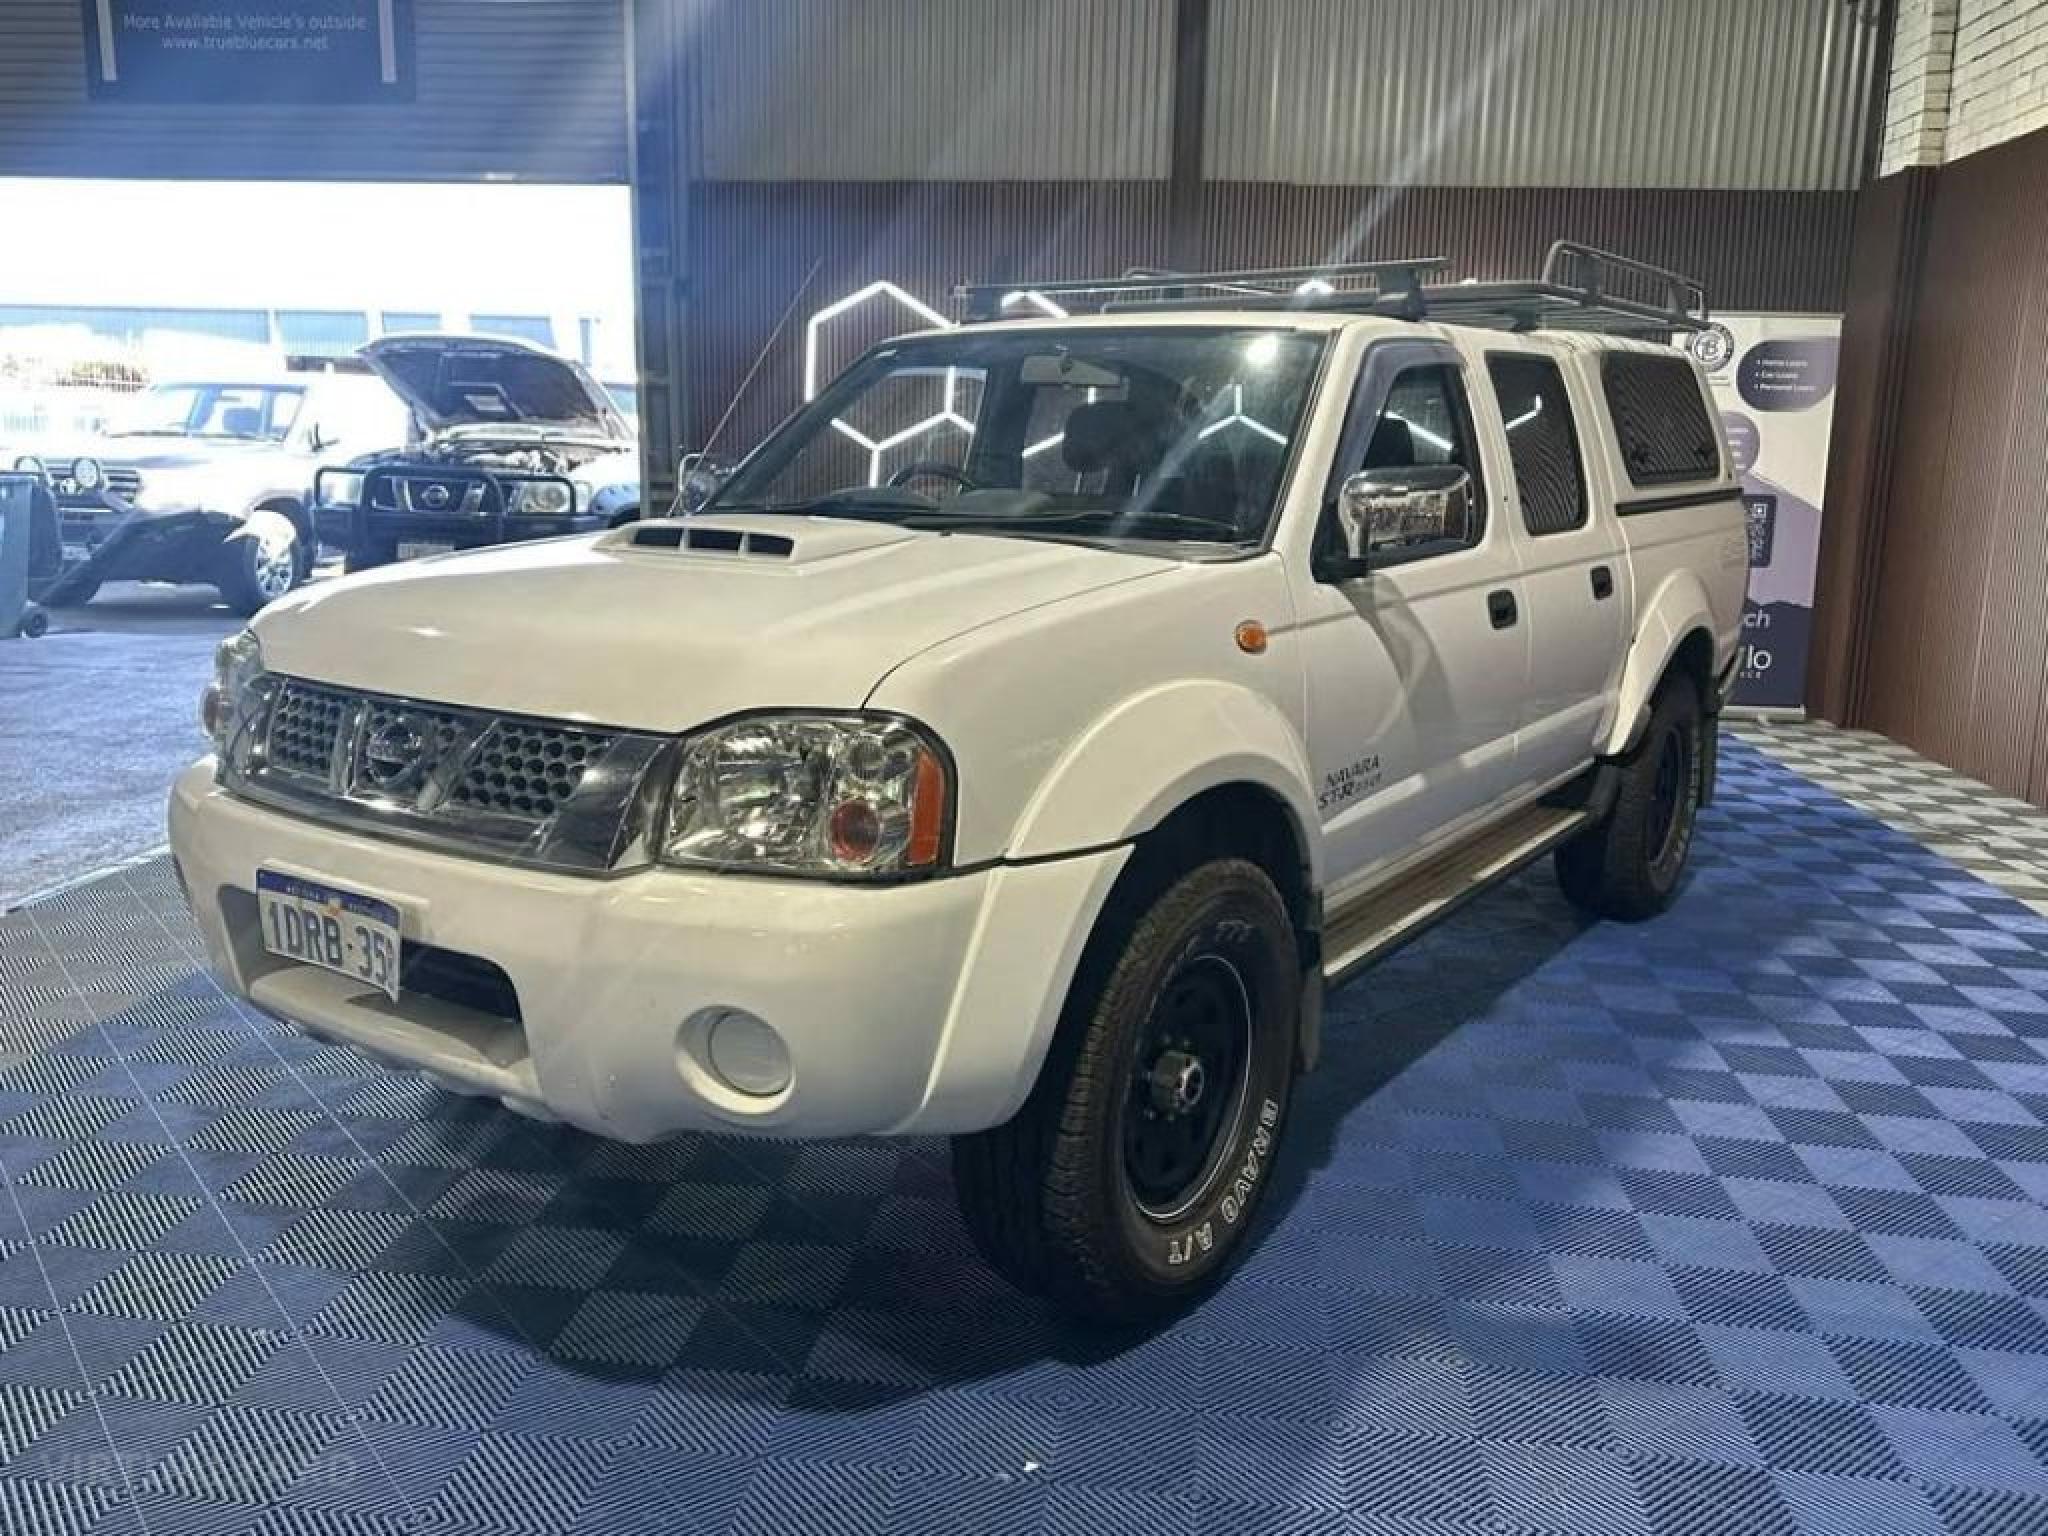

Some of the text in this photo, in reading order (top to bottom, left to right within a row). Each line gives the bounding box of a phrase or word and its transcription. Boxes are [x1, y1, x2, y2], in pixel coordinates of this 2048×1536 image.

[123, 13, 368, 30] More Available Vehicle's outside
[161, 34, 330, 50] www.truebluecars.net
[1326, 754, 1380, 788] NAVARA
[1221, 1098, 1279, 1224] BRAVO
[1168, 1221, 1213, 1265] A/T
